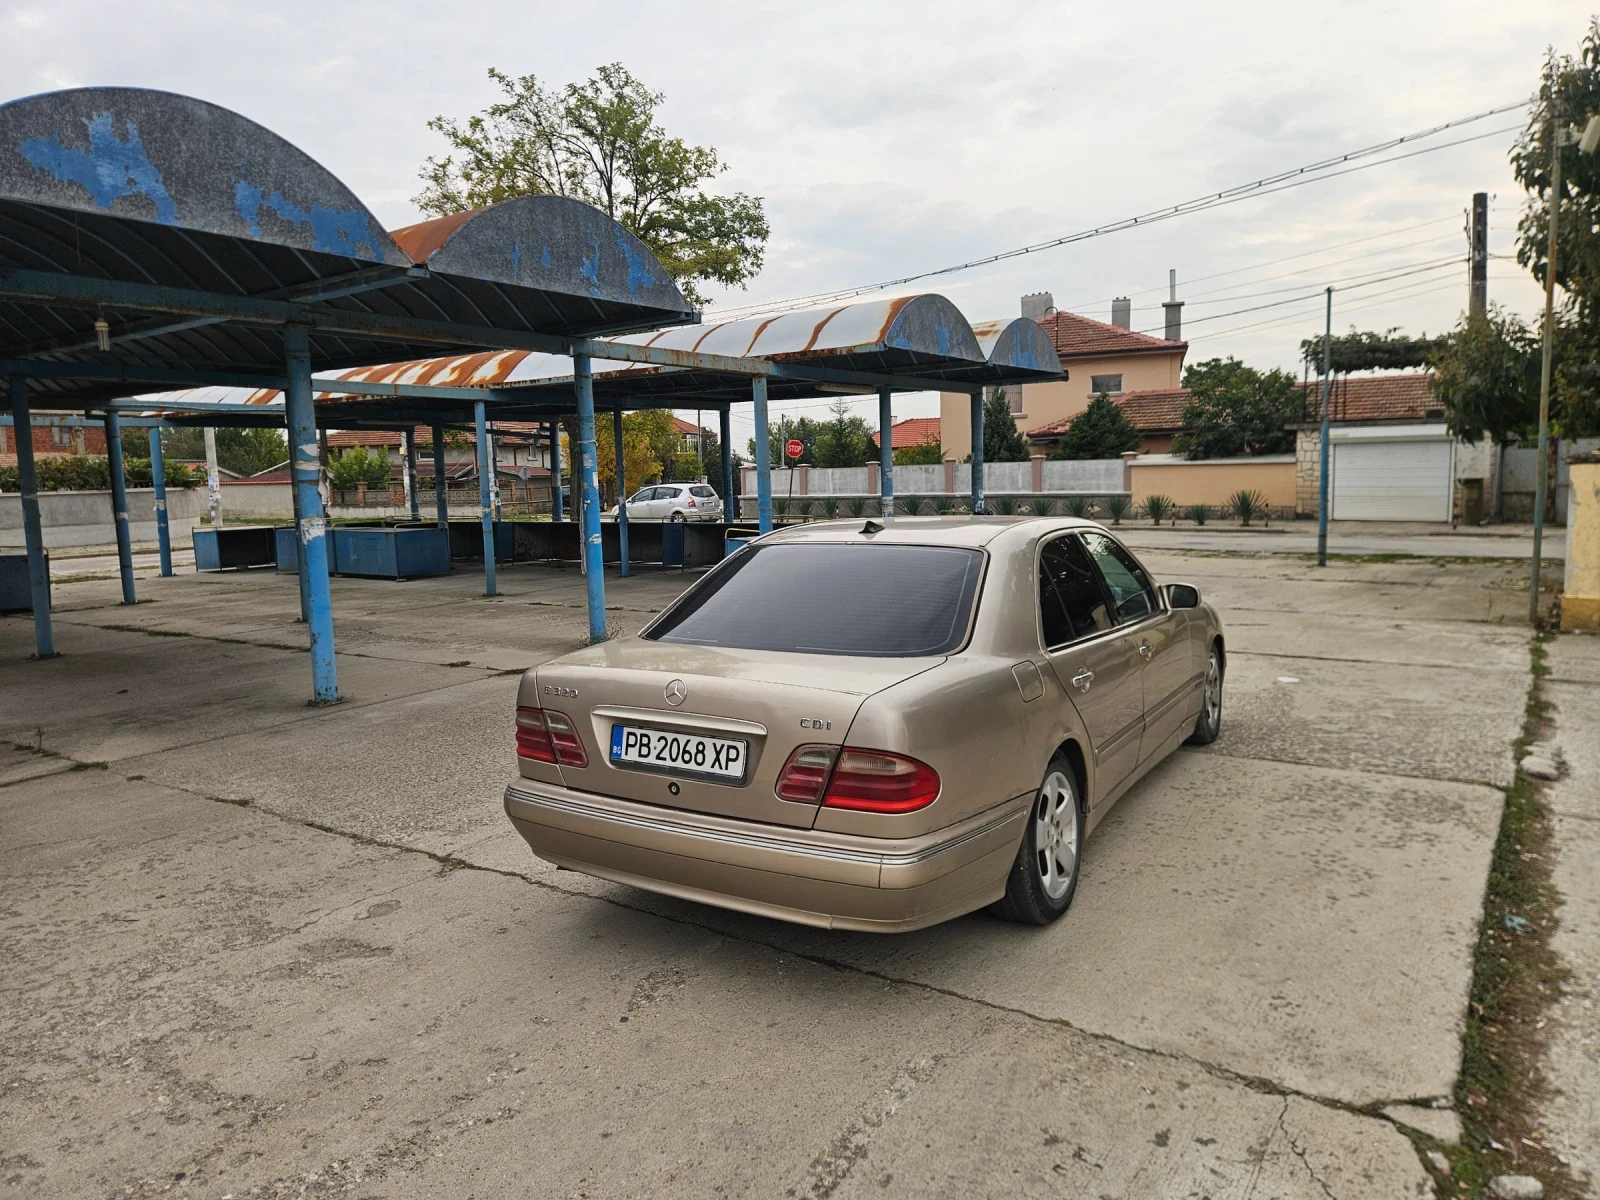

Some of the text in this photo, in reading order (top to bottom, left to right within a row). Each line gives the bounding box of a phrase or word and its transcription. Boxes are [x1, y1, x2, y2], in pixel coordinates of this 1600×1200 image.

[788, 444, 802, 452] STOP
[553, 686, 578, 698] 320
[800, 717, 832, 730] CDI
[612, 745, 622, 754] BG
[624, 731, 740, 770] PB 2068 XP
